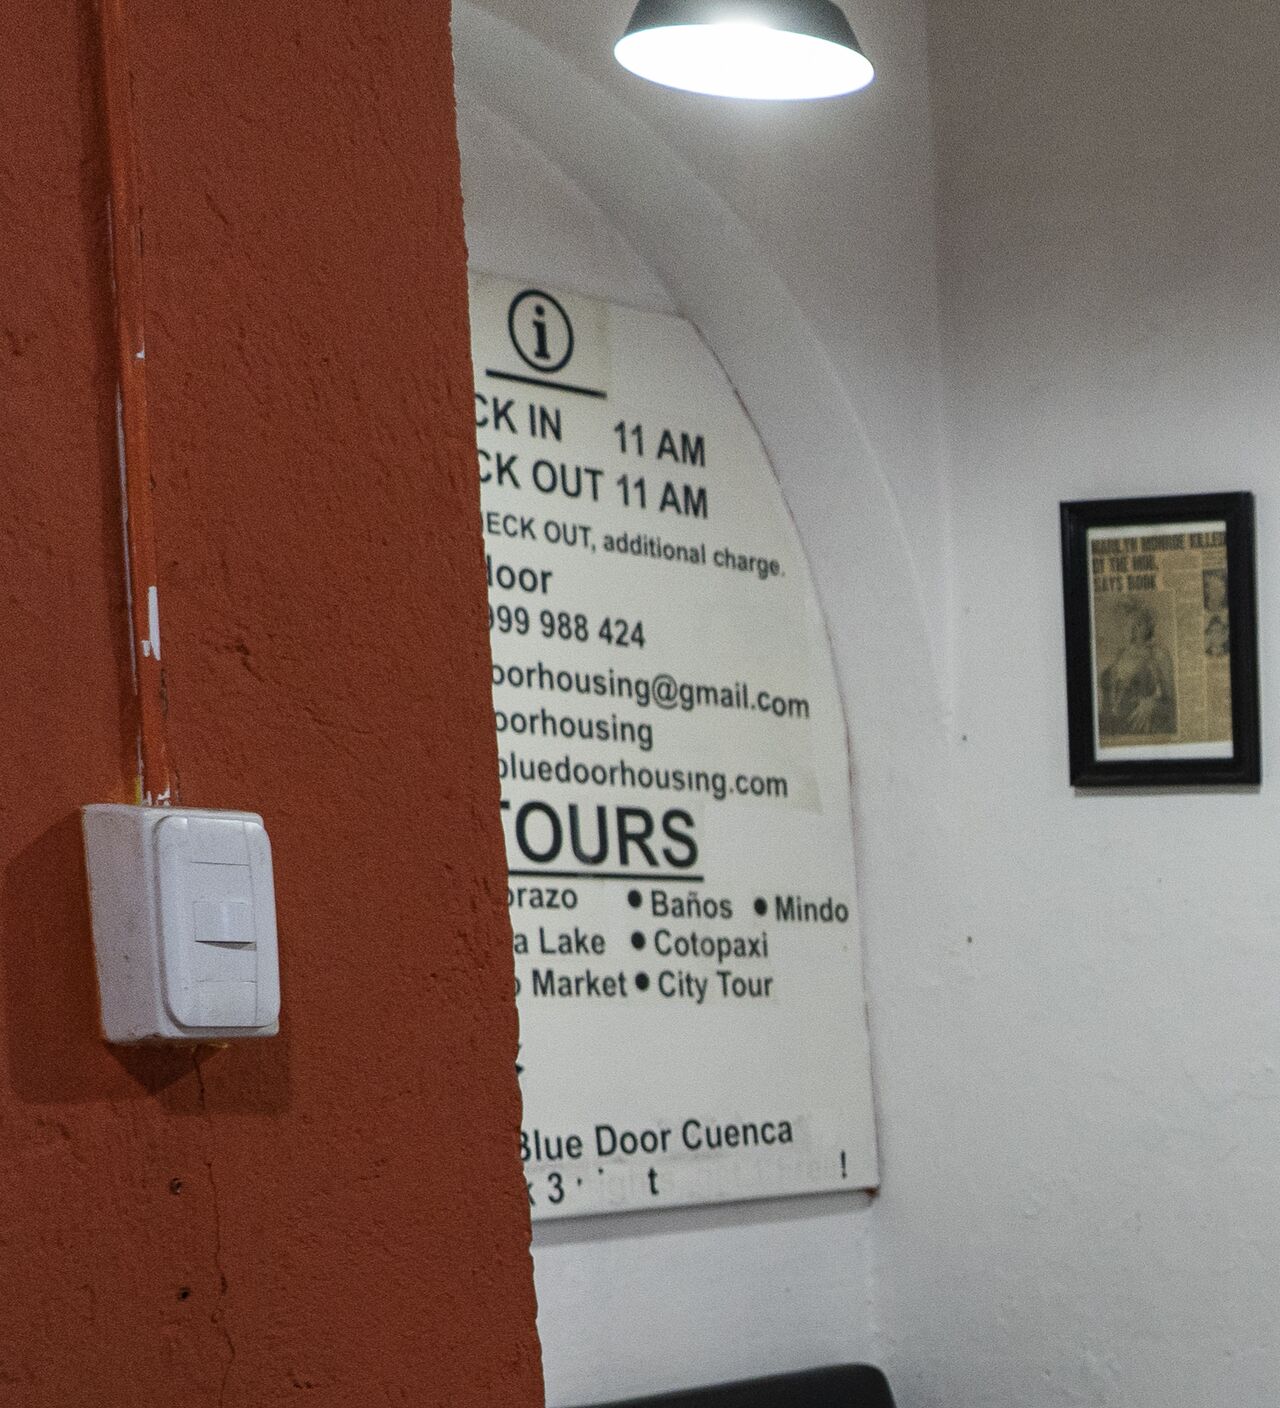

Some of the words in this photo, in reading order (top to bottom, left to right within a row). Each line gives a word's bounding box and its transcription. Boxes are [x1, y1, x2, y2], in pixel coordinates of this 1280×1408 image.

[528, 403, 562, 442] IN
[613, 420, 644, 457] 11
[656, 428, 706, 468] AM
[532, 459, 604, 502] OUT
[616, 473, 647, 509] 11
[658, 481, 709, 520] AM
[484, 511, 537, 541] ECK
[543, 520, 597, 553] OUT,
[603, 531, 706, 565] additional
[713, 547, 786, 580] charge.
[488, 603, 530, 637] 99
[539, 609, 589, 643] 988
[598, 616, 646, 649] 424
[501, 800, 699, 868] OURS
[651, 889, 734, 920] Baños
[774, 895, 850, 924] Mindo
[539, 926, 606, 956] Lake
[653, 928, 769, 964] Cotopaxi
[531, 967, 628, 998] Market
[657, 970, 708, 1005] City
[715, 970, 774, 998] Tour
[594, 1124, 672, 1157] Door
[681, 1118, 794, 1152] Cuenca
